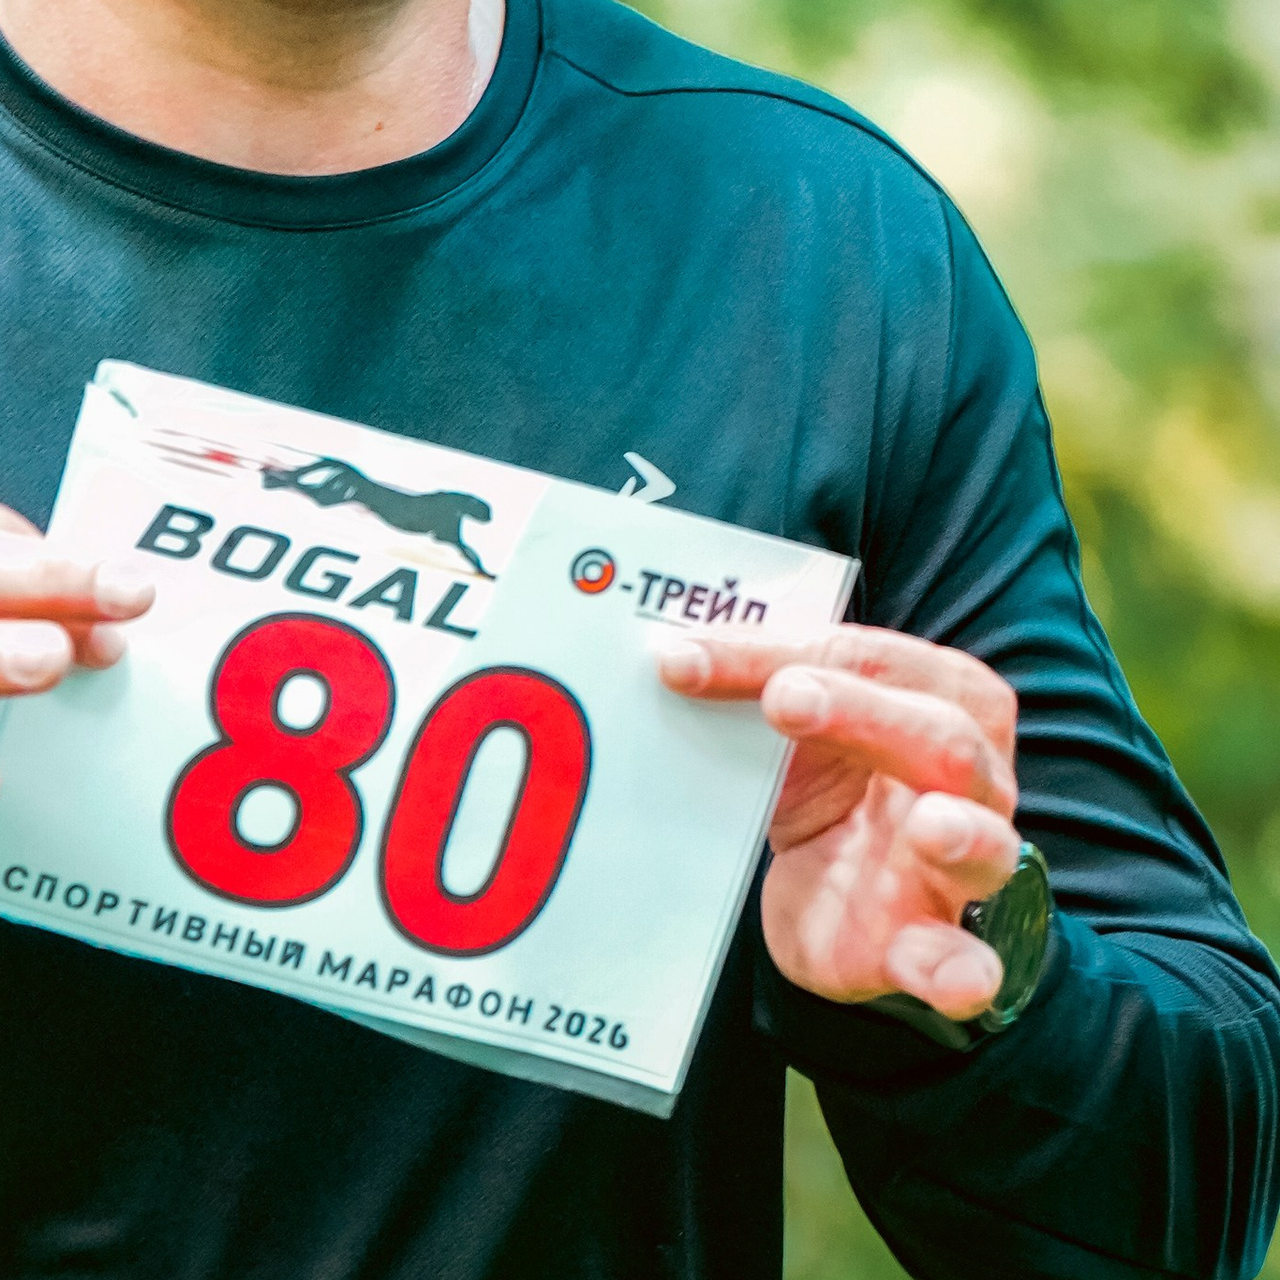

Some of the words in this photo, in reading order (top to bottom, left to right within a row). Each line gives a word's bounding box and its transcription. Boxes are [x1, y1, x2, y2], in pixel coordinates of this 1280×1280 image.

[135, 504, 479, 639] BOGAL
[166, 611, 592, 957] 80
[3, 866, 306, 969] СПОРТИВНЫЙ
[318, 950, 533, 1025] МАРАФОН
[543, 1005, 629, 1050] 2026
